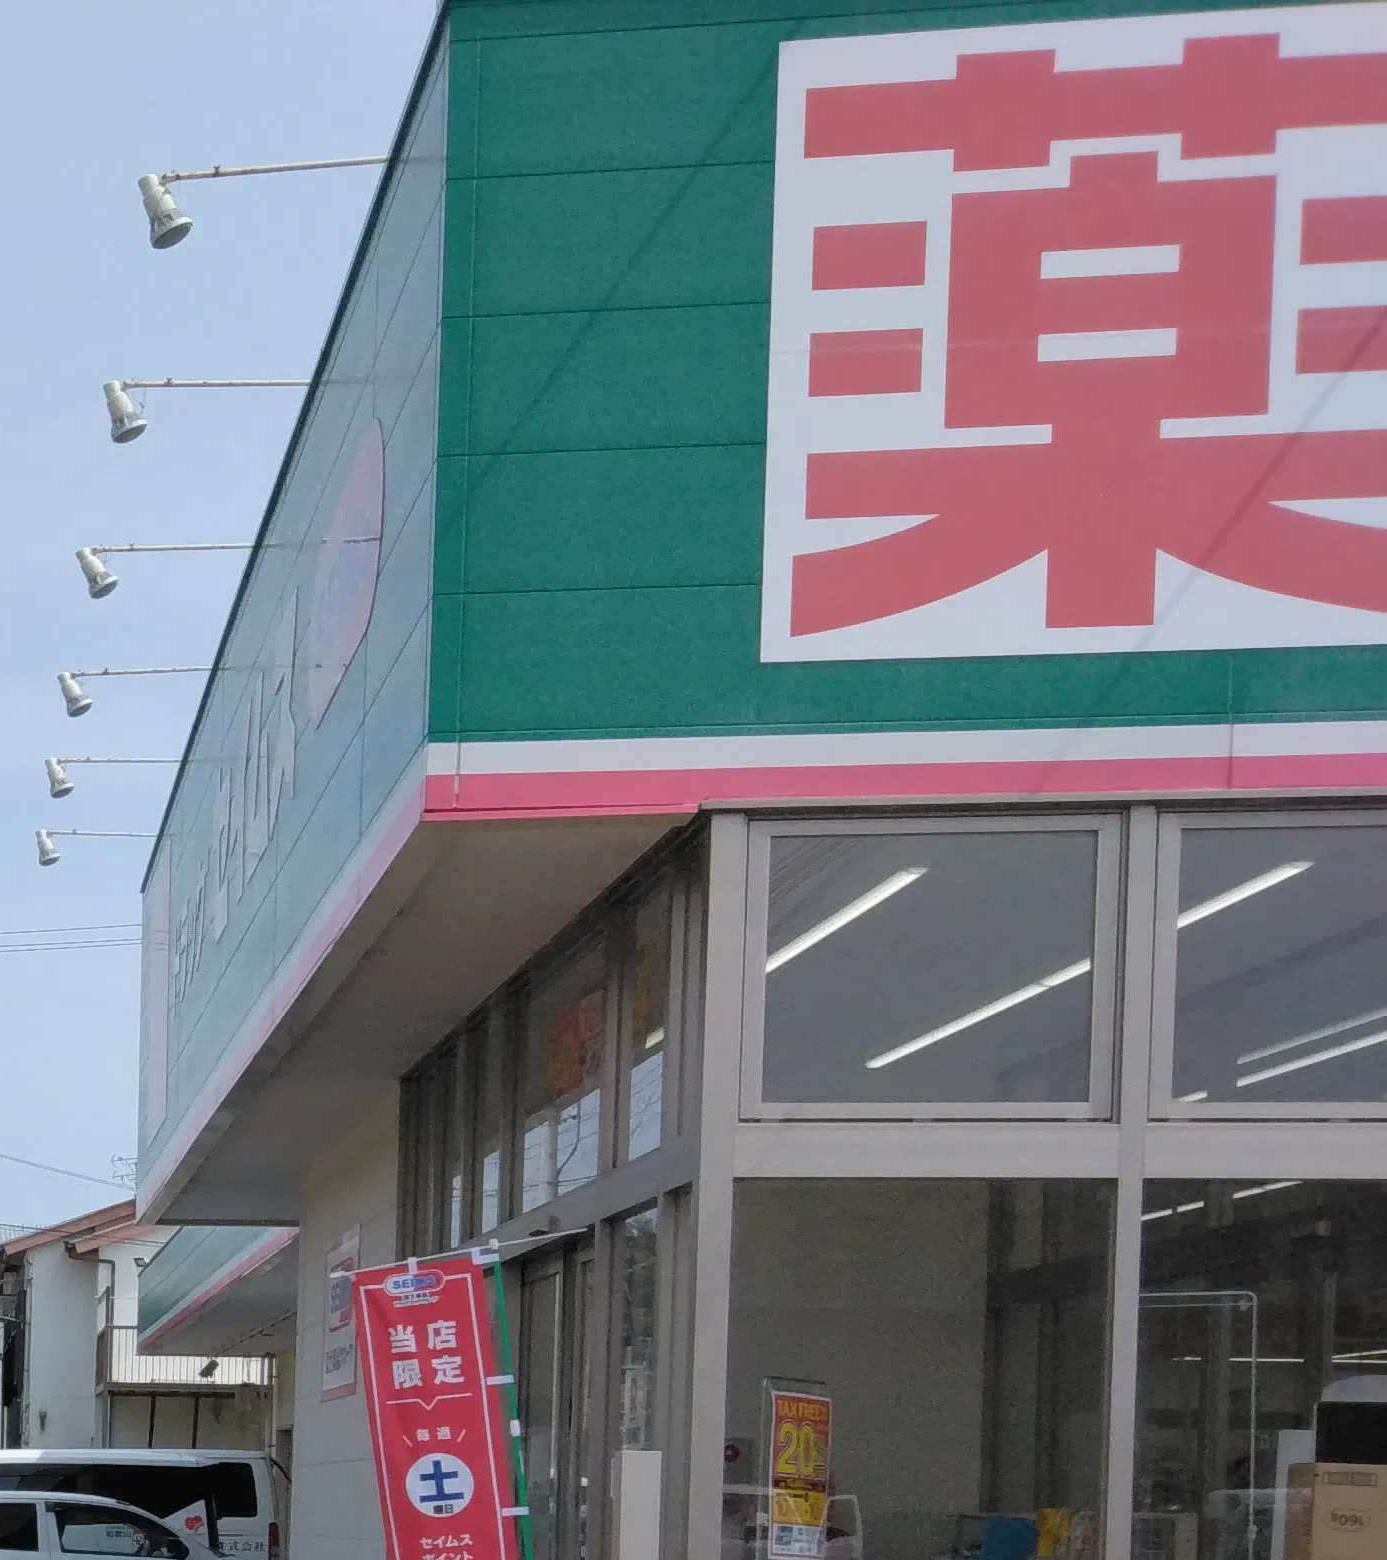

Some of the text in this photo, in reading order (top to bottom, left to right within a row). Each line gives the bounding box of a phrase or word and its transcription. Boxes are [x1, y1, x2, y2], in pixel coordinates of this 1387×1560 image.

[790, 33, 1387, 638] 薬
[388, 1320, 458, 1354] 当店
[392, 1354, 465, 1389] 限定
[419, 1460, 465, 1503] 土
[420, 1533, 474, 1550] セイムス
